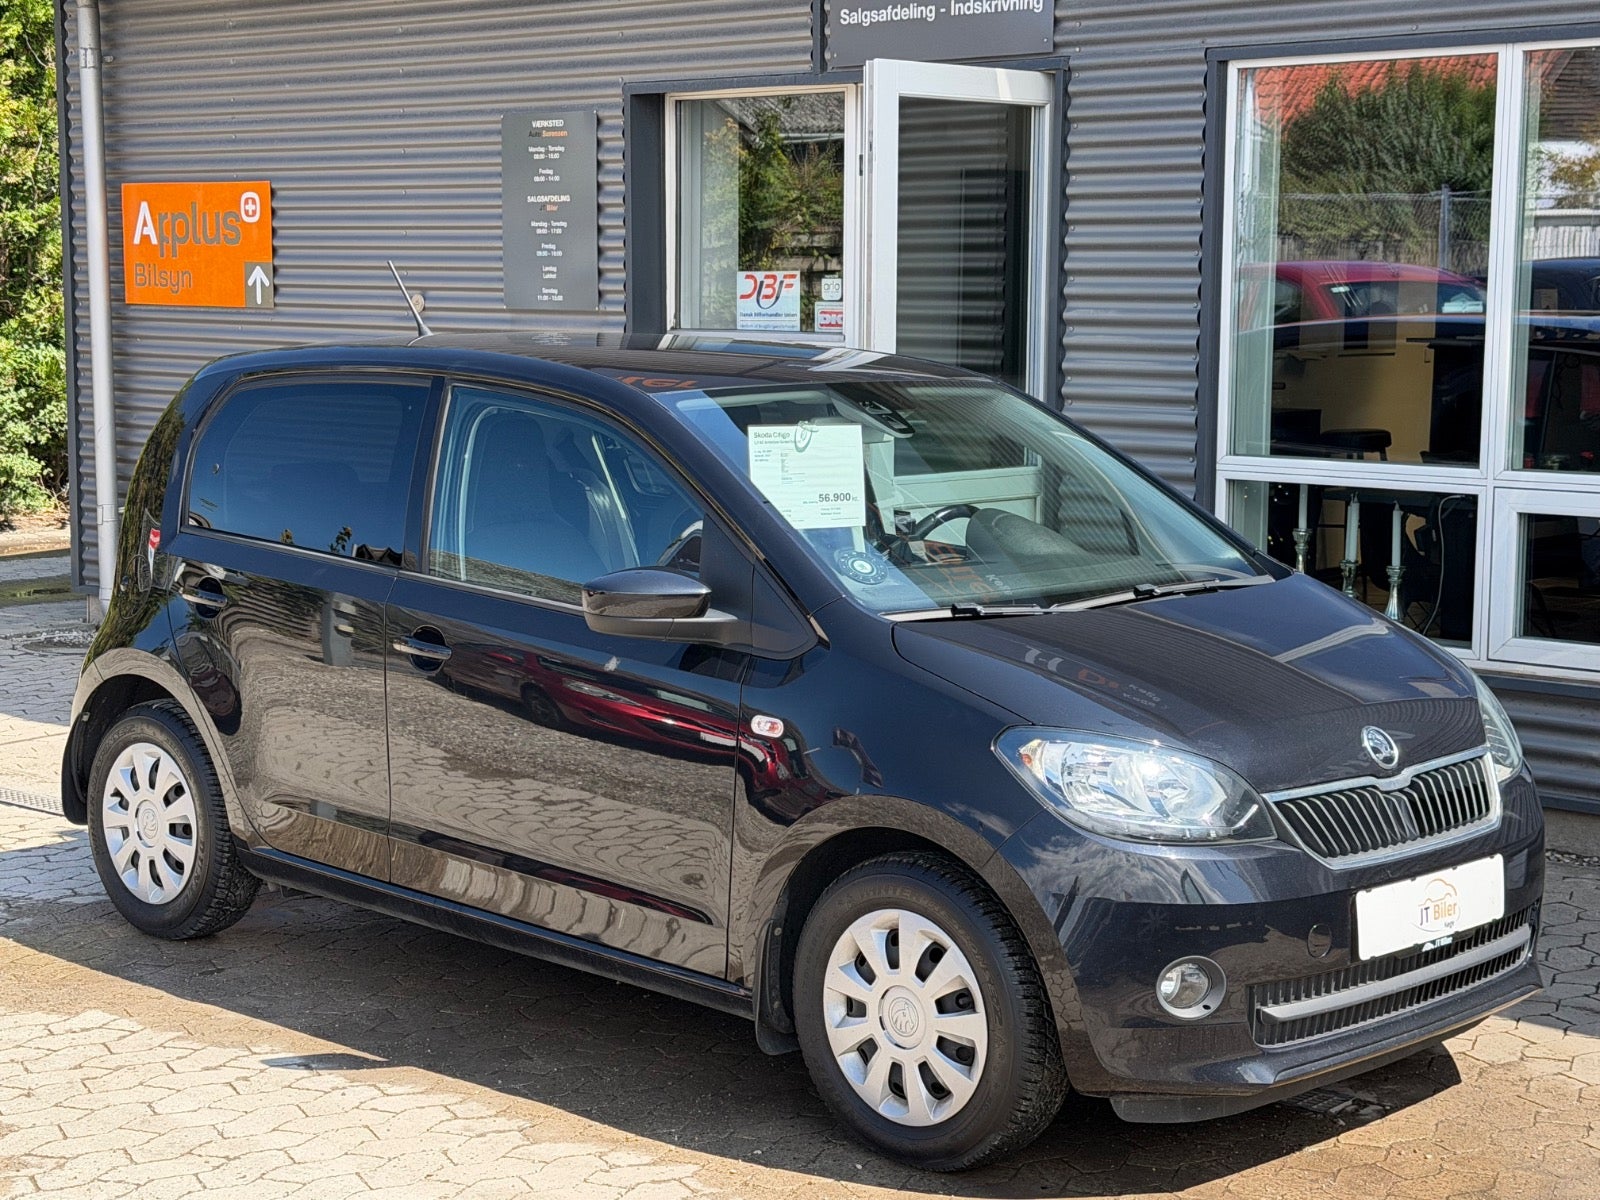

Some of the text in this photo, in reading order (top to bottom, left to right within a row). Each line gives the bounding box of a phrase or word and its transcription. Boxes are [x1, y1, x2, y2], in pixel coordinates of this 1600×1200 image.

[840, 4, 936, 27] Salgsafdeling
[950, 0, 1044, 17] Indskrivning
[134, 262, 193, 295] Bilsyn
[818, 492, 852, 503] 56.900
[1420, 902, 1458, 926] JT Biler
